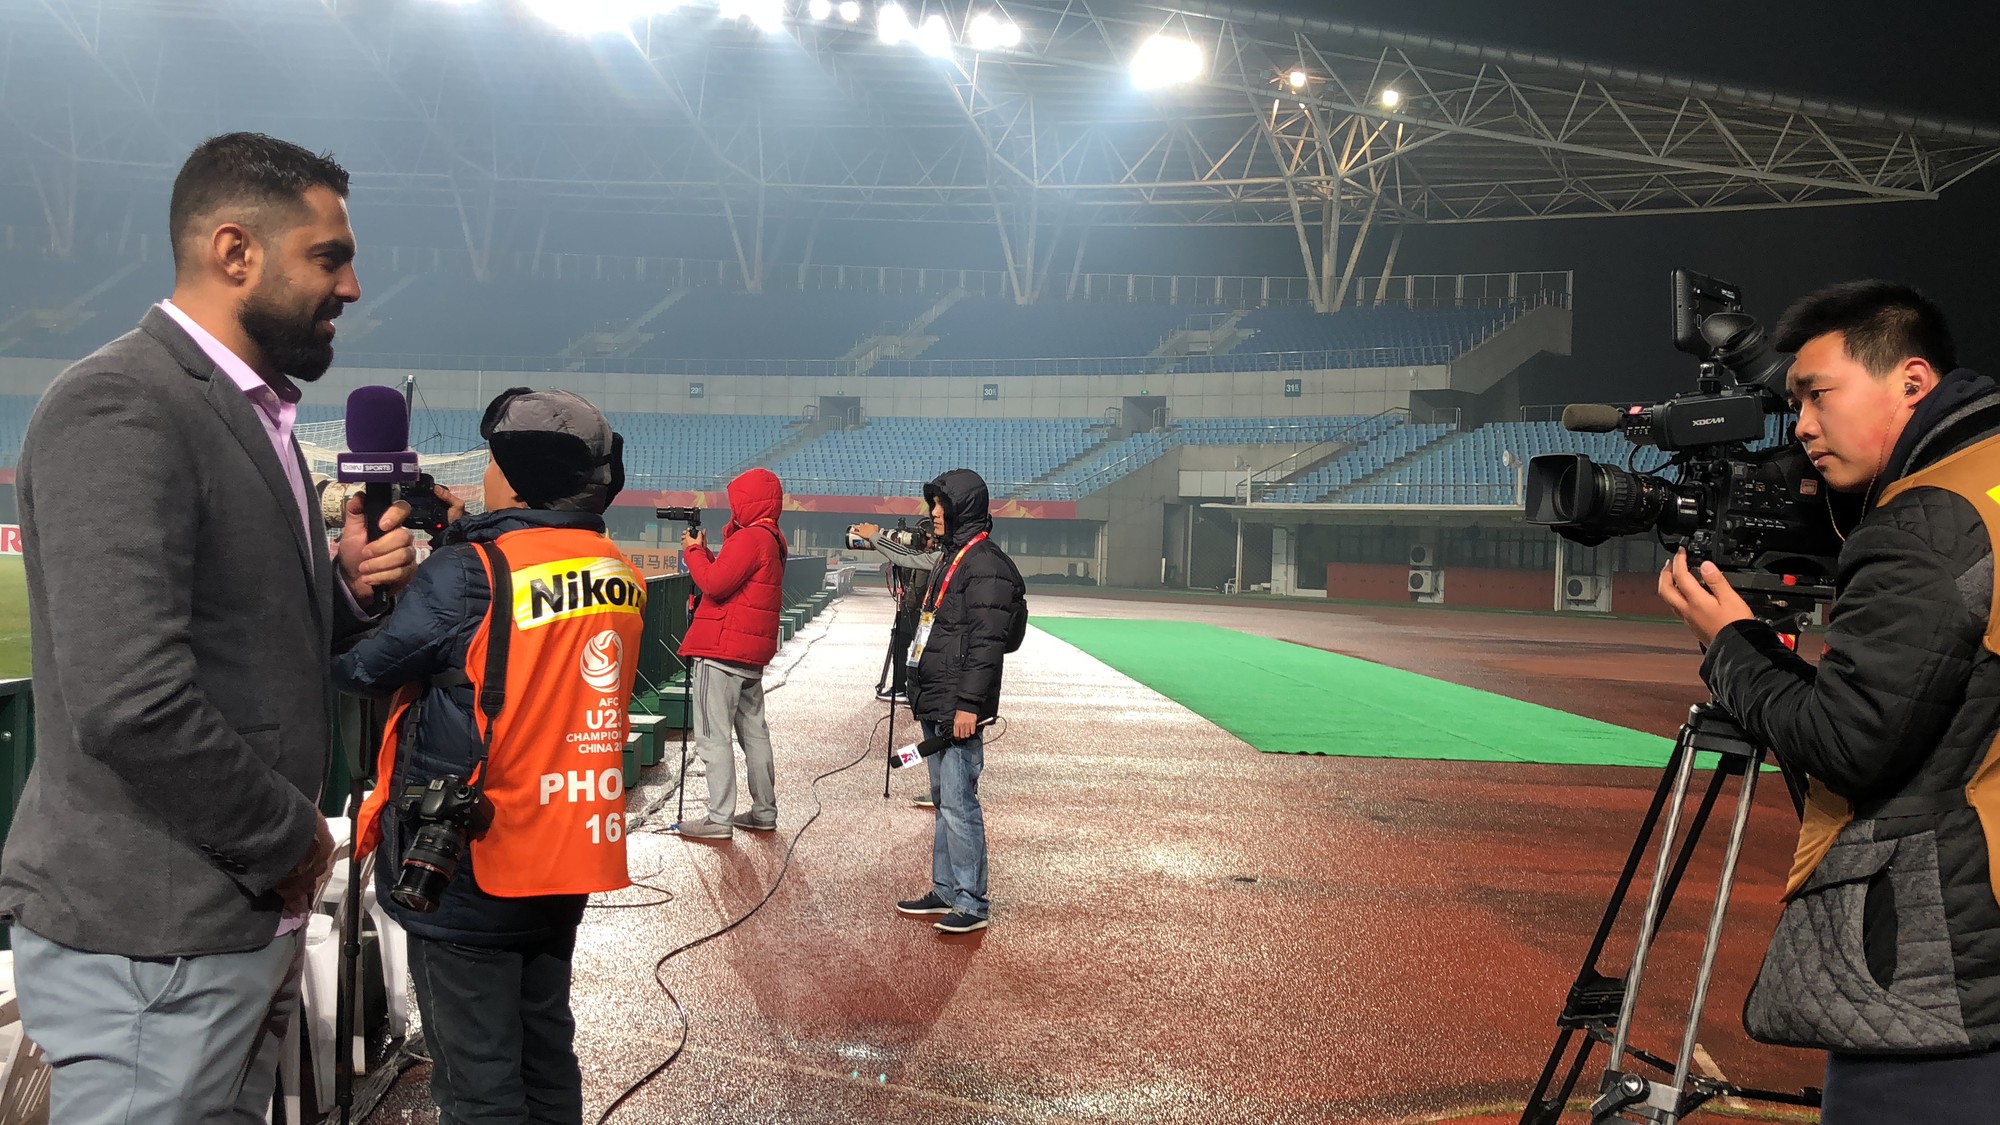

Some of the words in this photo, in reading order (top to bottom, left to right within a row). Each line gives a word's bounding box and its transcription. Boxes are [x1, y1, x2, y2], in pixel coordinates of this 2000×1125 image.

[1692, 416, 1725, 427] XDCAM
[622, 553, 678, 570] 国马牌
[530, 570, 642, 619] Nikon
[598, 697, 619, 707] AFC
[578, 743, 613, 754] CHINA
